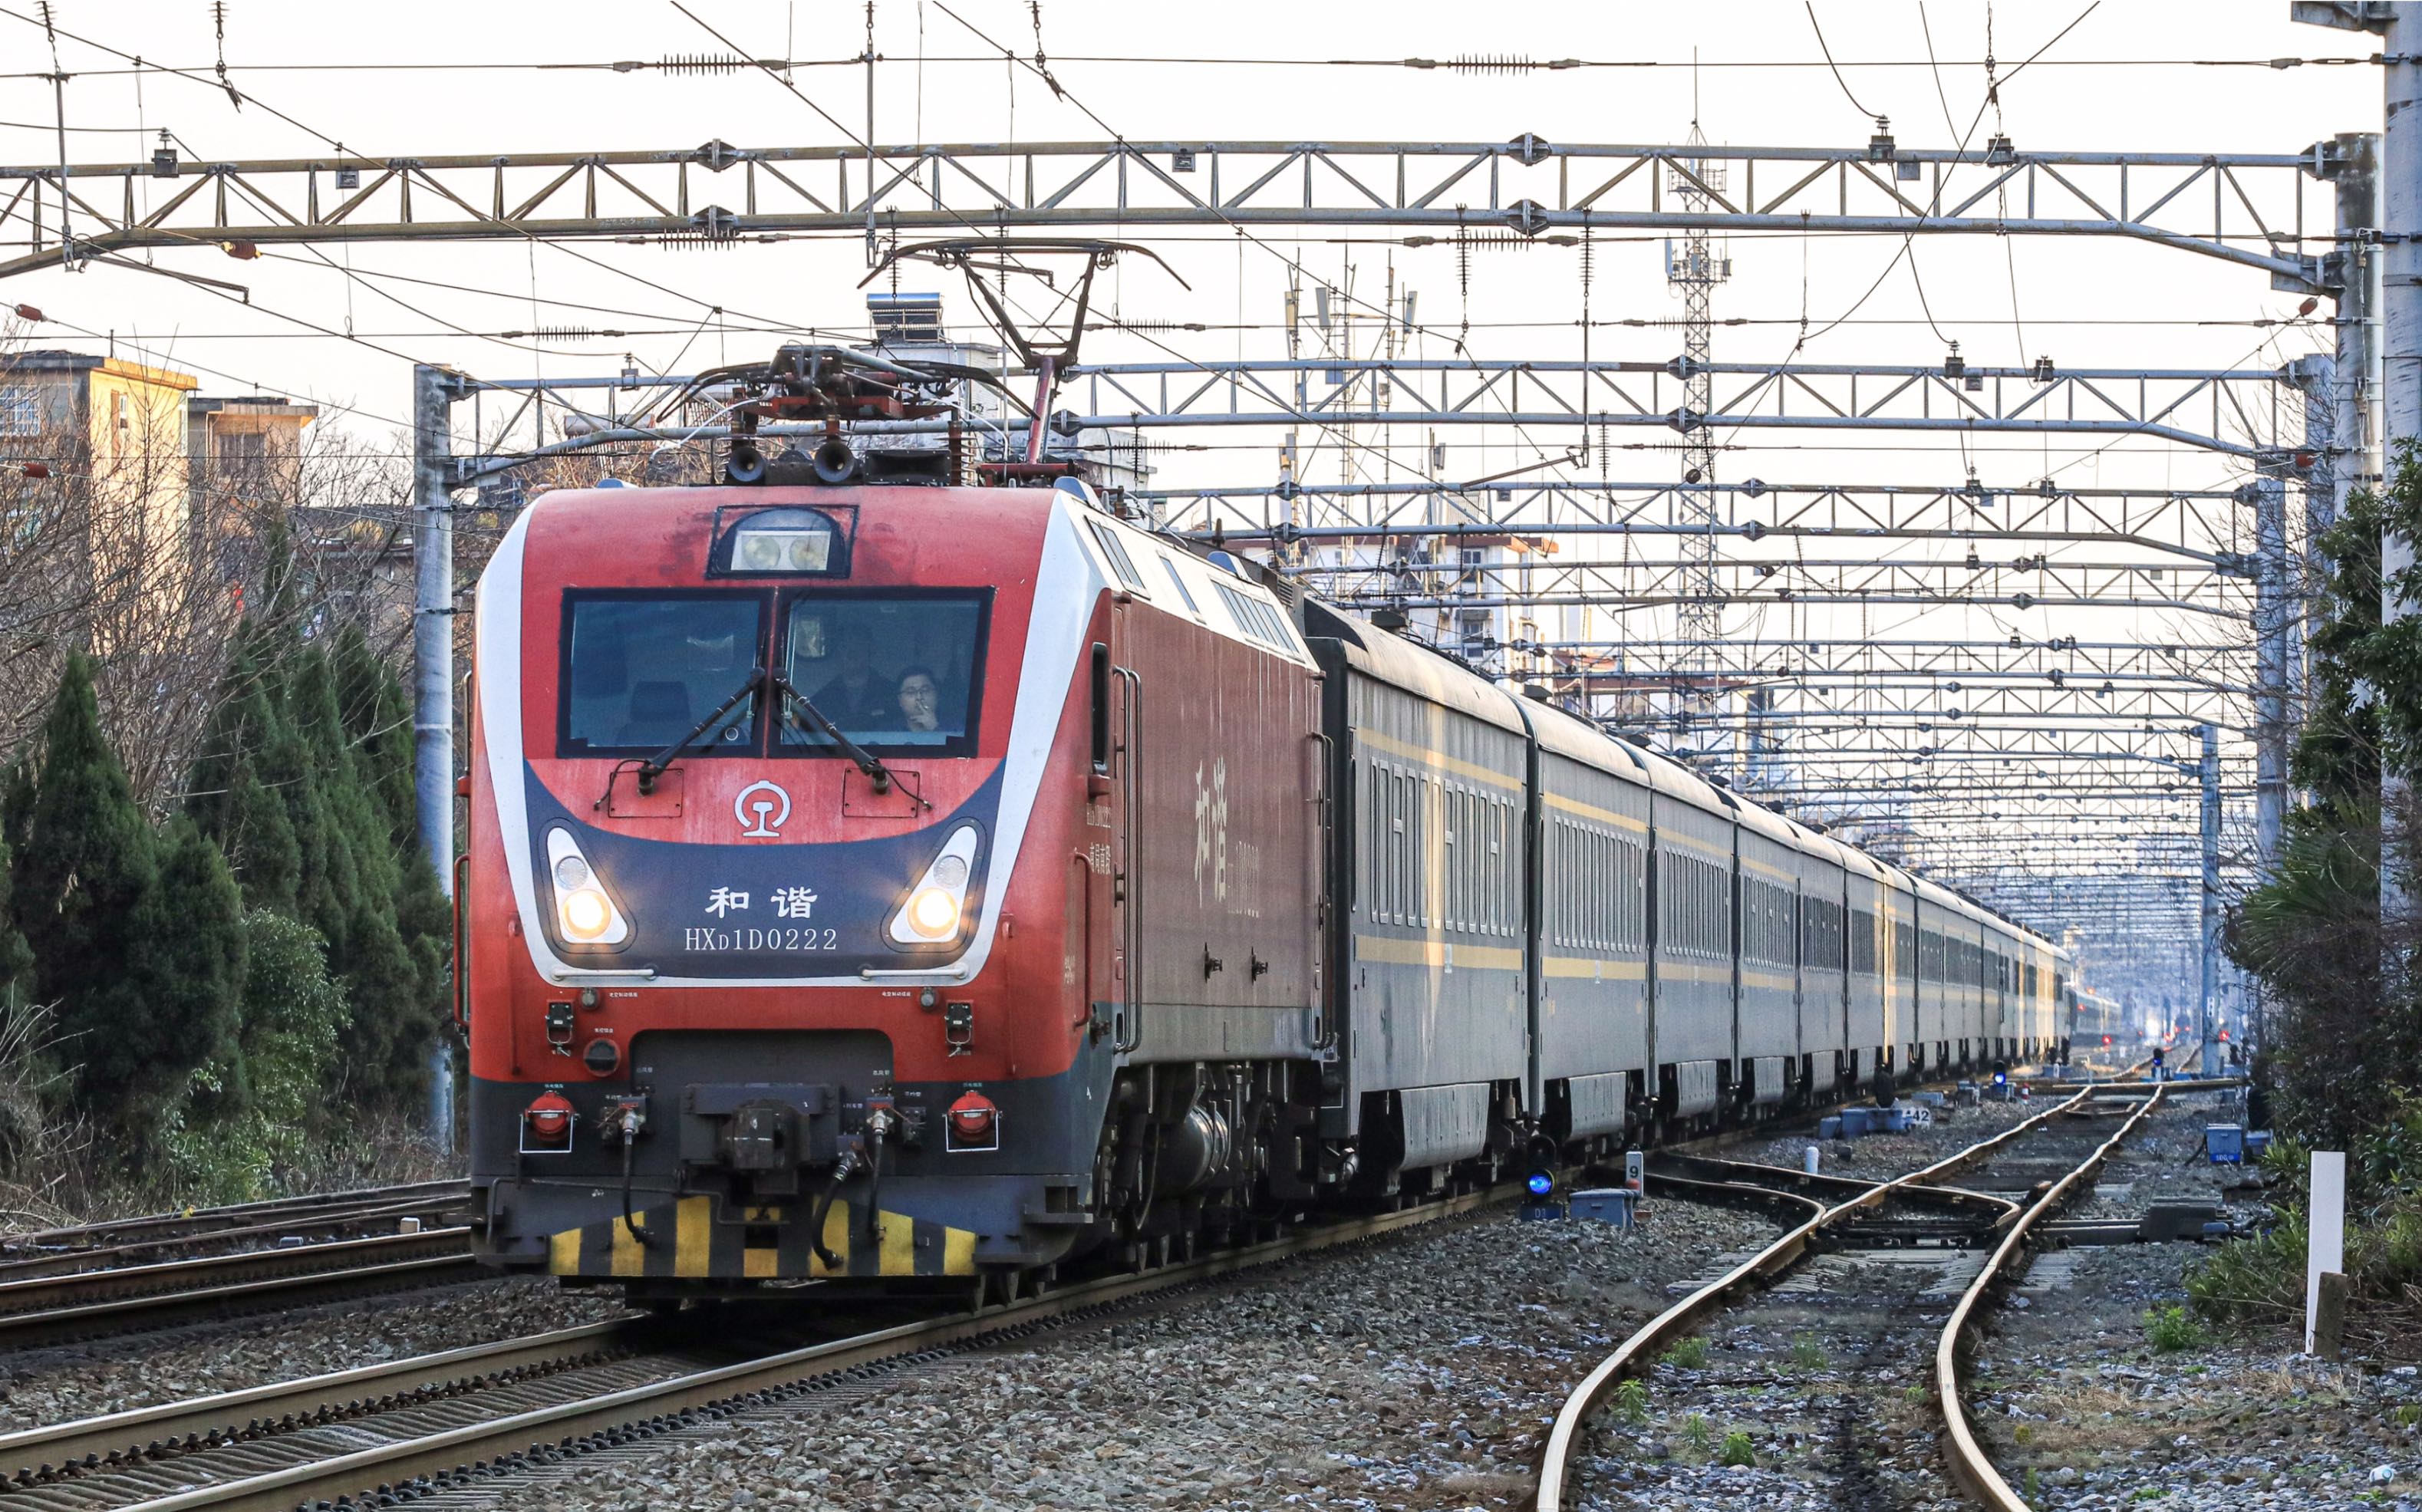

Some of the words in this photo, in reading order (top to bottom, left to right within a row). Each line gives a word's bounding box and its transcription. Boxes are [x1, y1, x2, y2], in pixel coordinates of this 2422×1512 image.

[1195, 755, 1227, 908] 和谐
[705, 886, 818, 919] 和谐
[684, 927, 837, 951] HXD1D0222
[1629, 1165, 1639, 1178] 9
